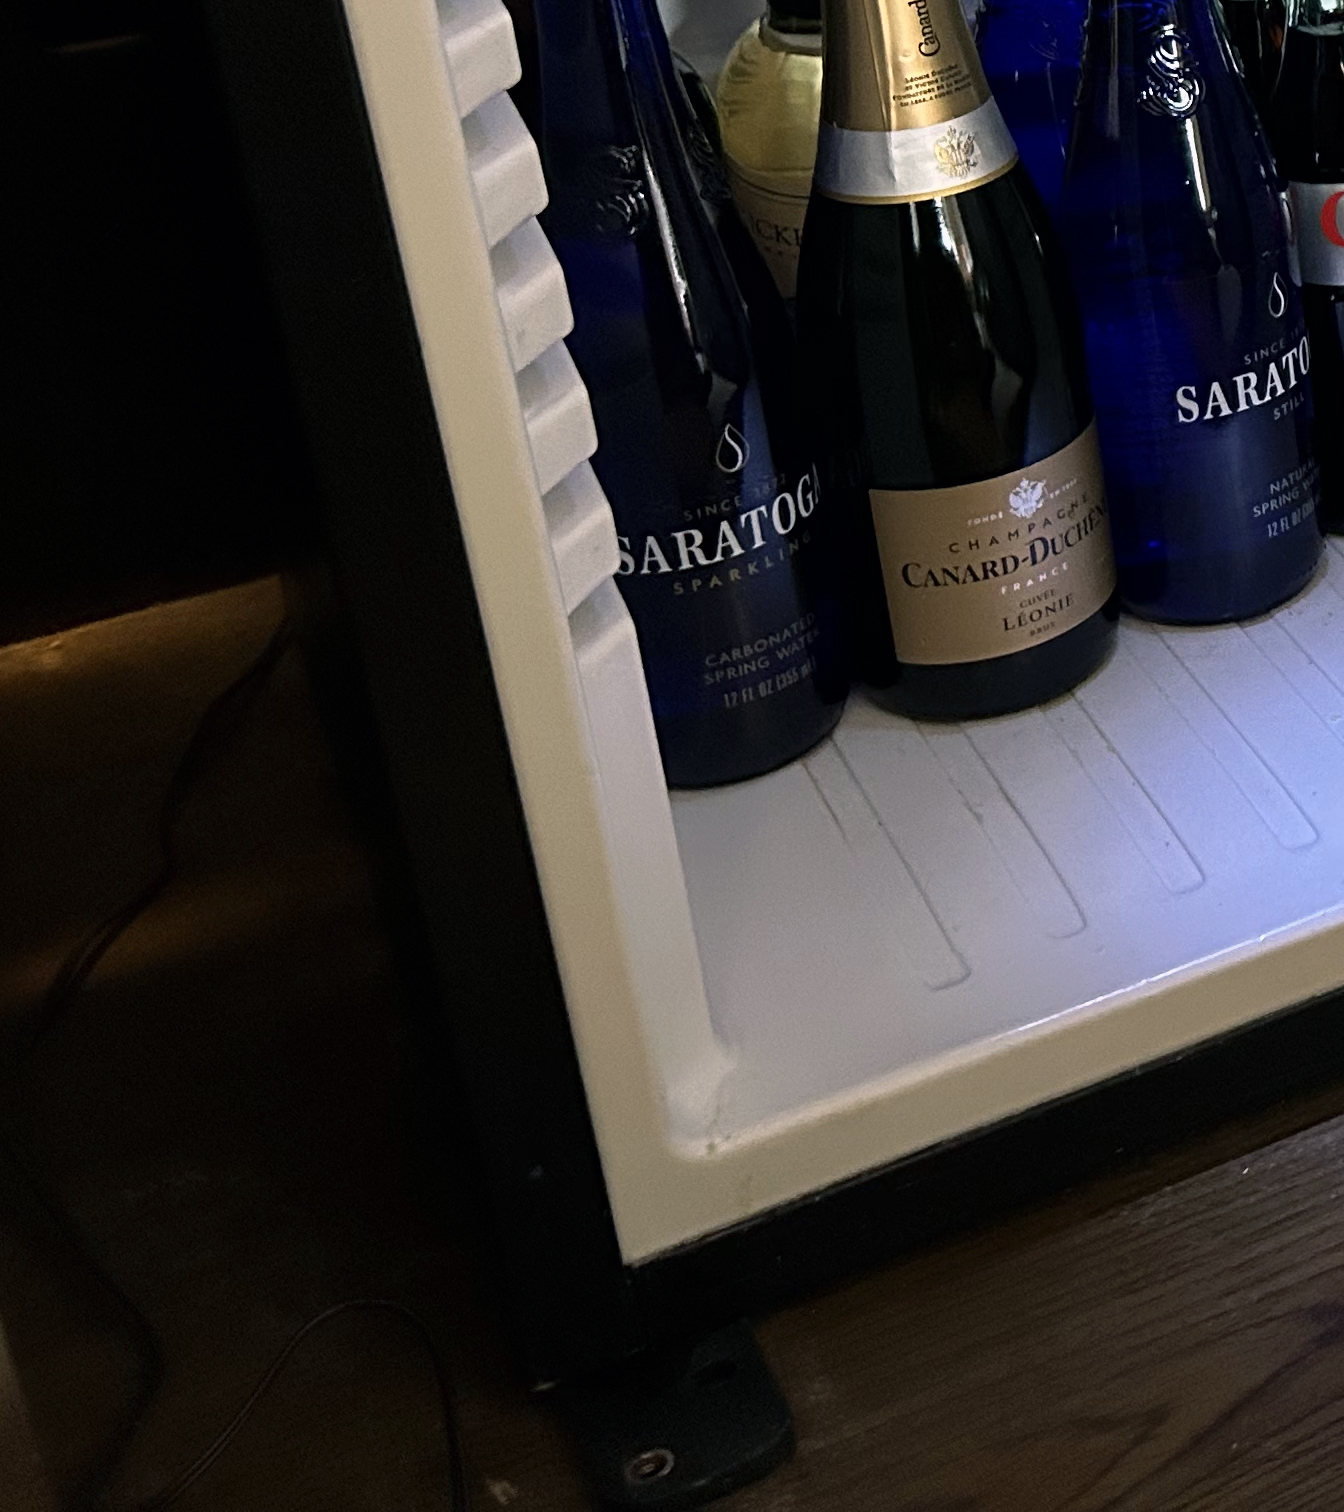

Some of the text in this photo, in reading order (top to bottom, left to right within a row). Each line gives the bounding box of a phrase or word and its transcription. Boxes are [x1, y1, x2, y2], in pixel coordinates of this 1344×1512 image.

[1244, 338, 1286, 366] SINCE
[1175, 335, 1311, 424] SARATO
[1273, 393, 1305, 421] STILL
[683, 494, 742, 522] SINCE
[1253, 488, 1300, 519] SPRING
[949, 493, 1088, 554] CHAMPAGNE
[1267, 522, 1278, 538] 12
[1001, 561, 1070, 595] FRANCE
[1002, 592, 1075, 632] LÉONIE
[705, 613, 817, 667] CARBONATED
[1029, 620, 1057, 637] BRUT
[704, 656, 770, 687] SPRING
[723, 691, 739, 710] 12
